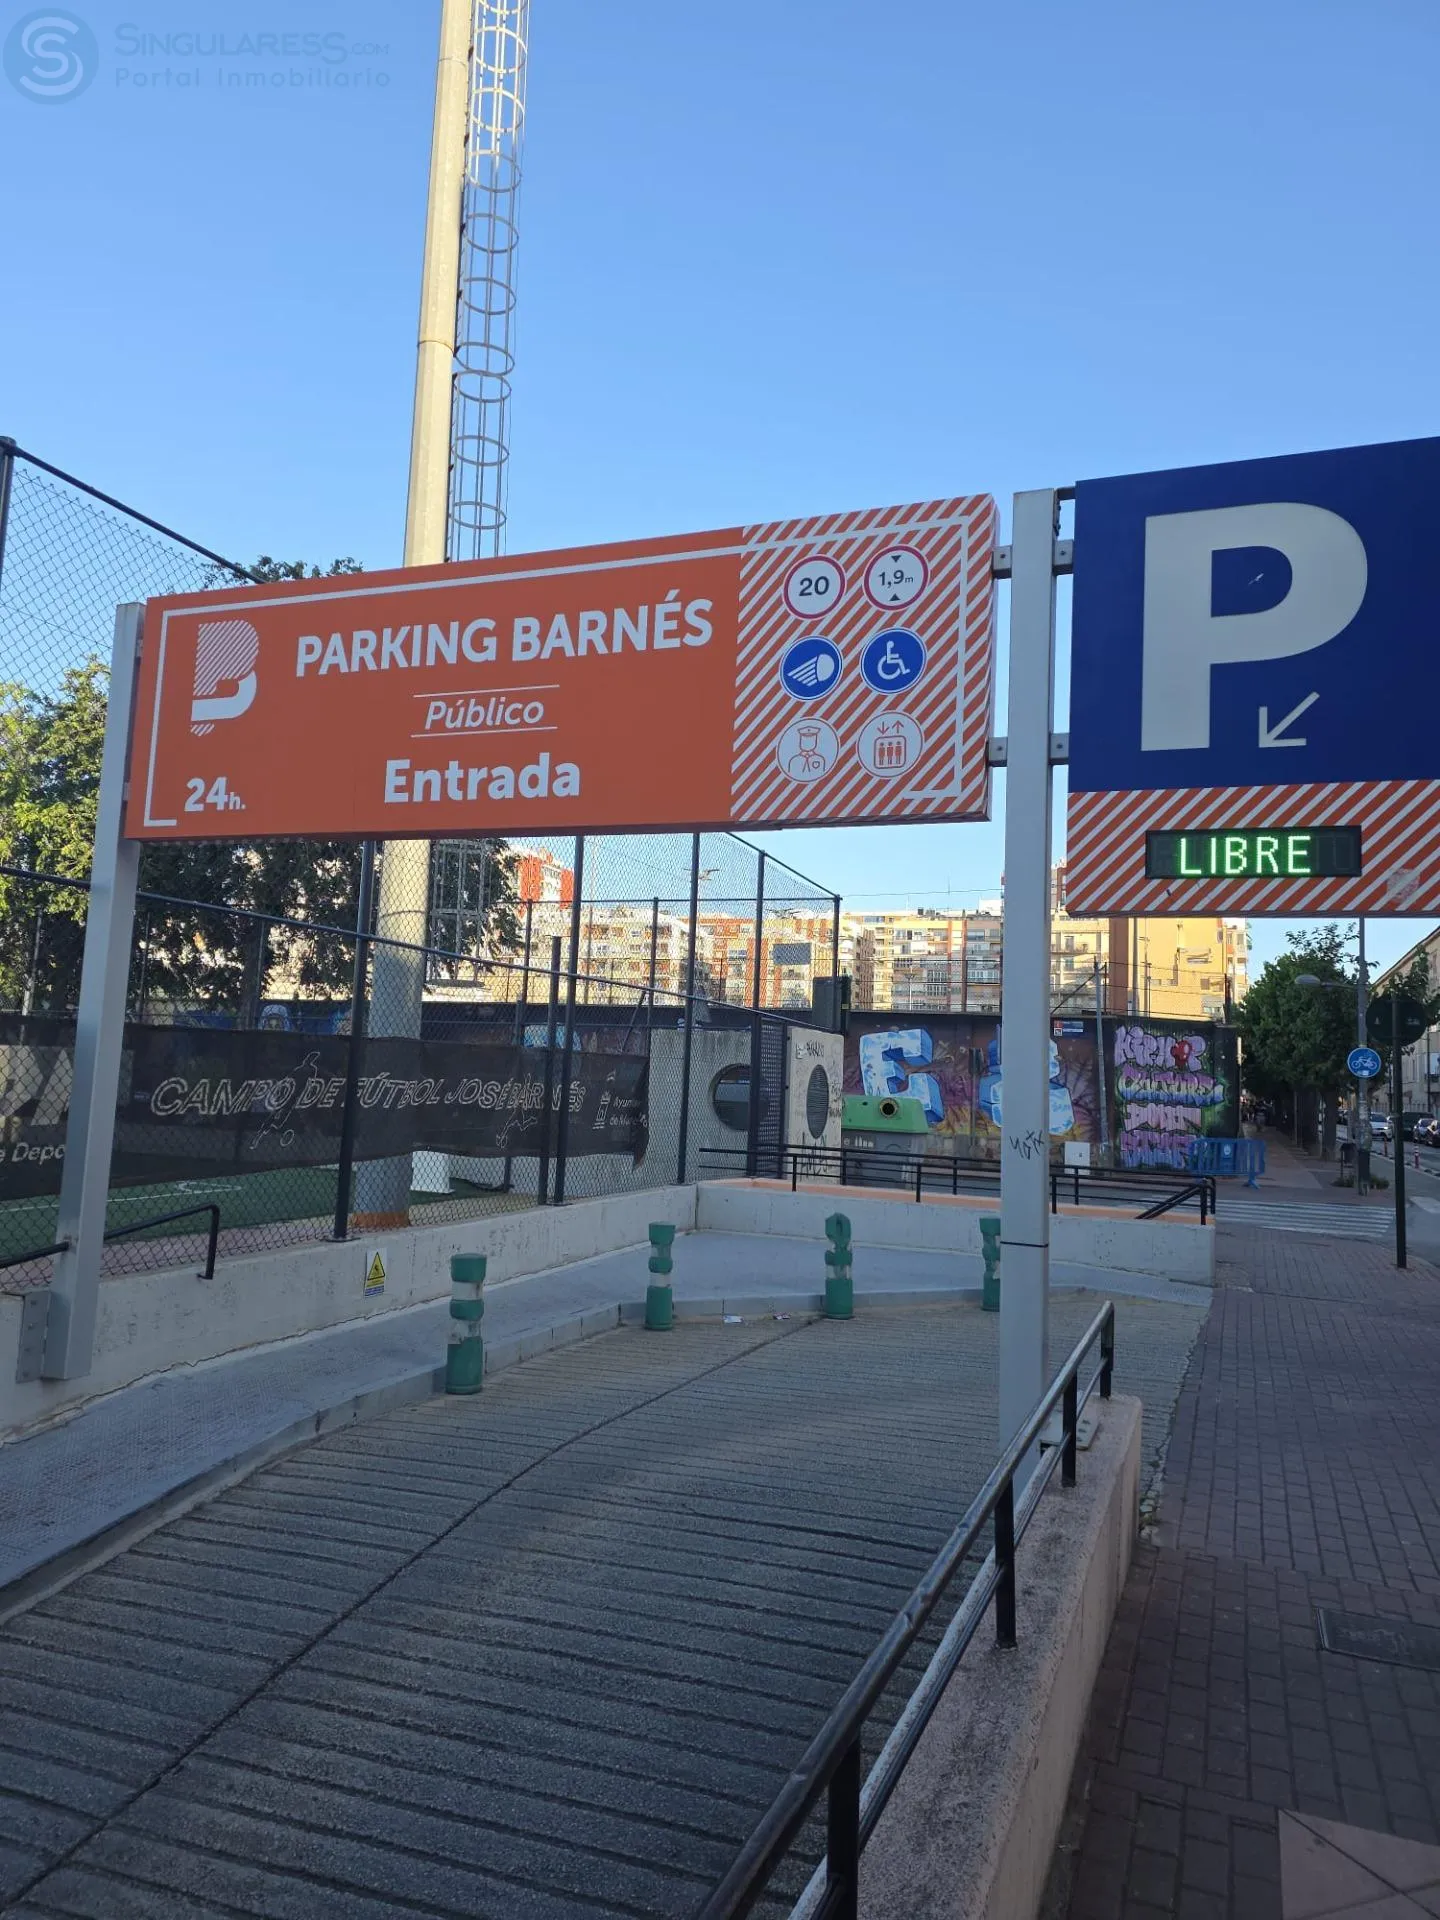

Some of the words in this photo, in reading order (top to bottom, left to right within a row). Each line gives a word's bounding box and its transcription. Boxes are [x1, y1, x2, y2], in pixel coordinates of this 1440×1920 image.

[799, 575, 830, 597] 20
[296, 618, 498, 678] PARKING
[512, 589, 714, 662] BARNÉS
[1141, 502, 1368, 751] P
[424, 697, 545, 731] Público
[384, 752, 582, 804] Entrada
[1179, 834, 1313, 876] LIBRE
[150, 1076, 297, 1116] CAMPO
[295, 1077, 346, 1109] DE
[445, 1077, 510, 1110] JOSÉ
[11, 1142, 66, 1165] Depo
